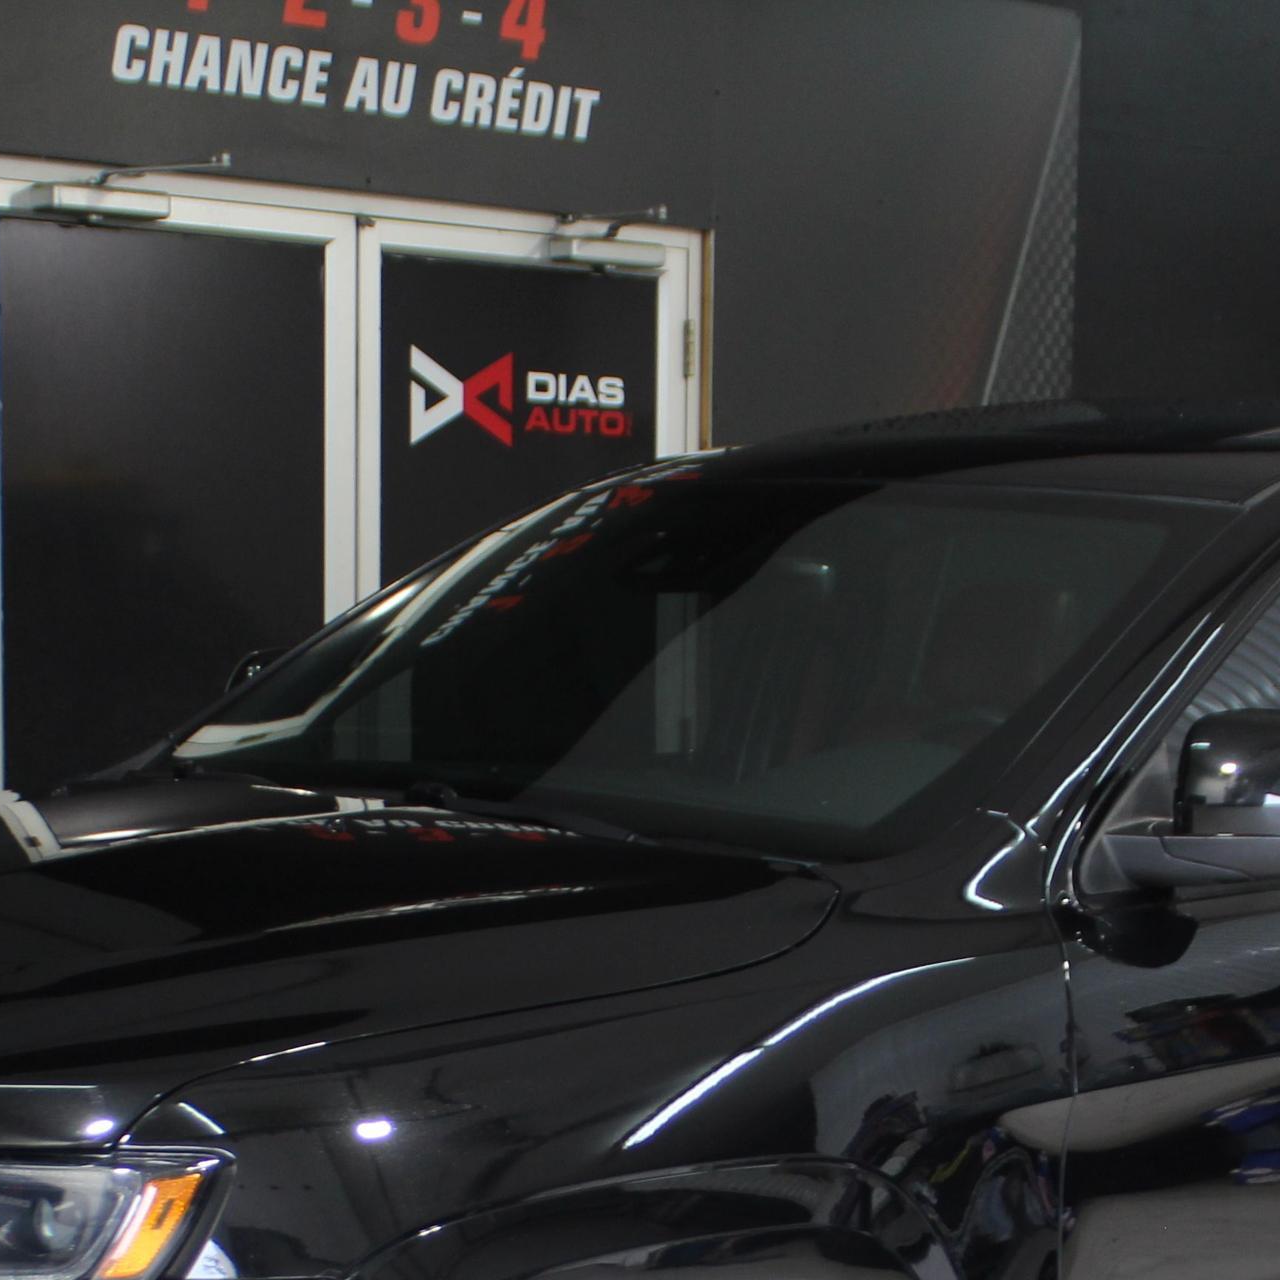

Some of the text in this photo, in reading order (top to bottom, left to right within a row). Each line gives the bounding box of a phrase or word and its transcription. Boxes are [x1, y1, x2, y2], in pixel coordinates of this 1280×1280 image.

[111, 23, 600, 142] CHANCE AU CRÉDIT
[527, 371, 625, 407] DIAS
[525, 405, 625, 437] AUTO
